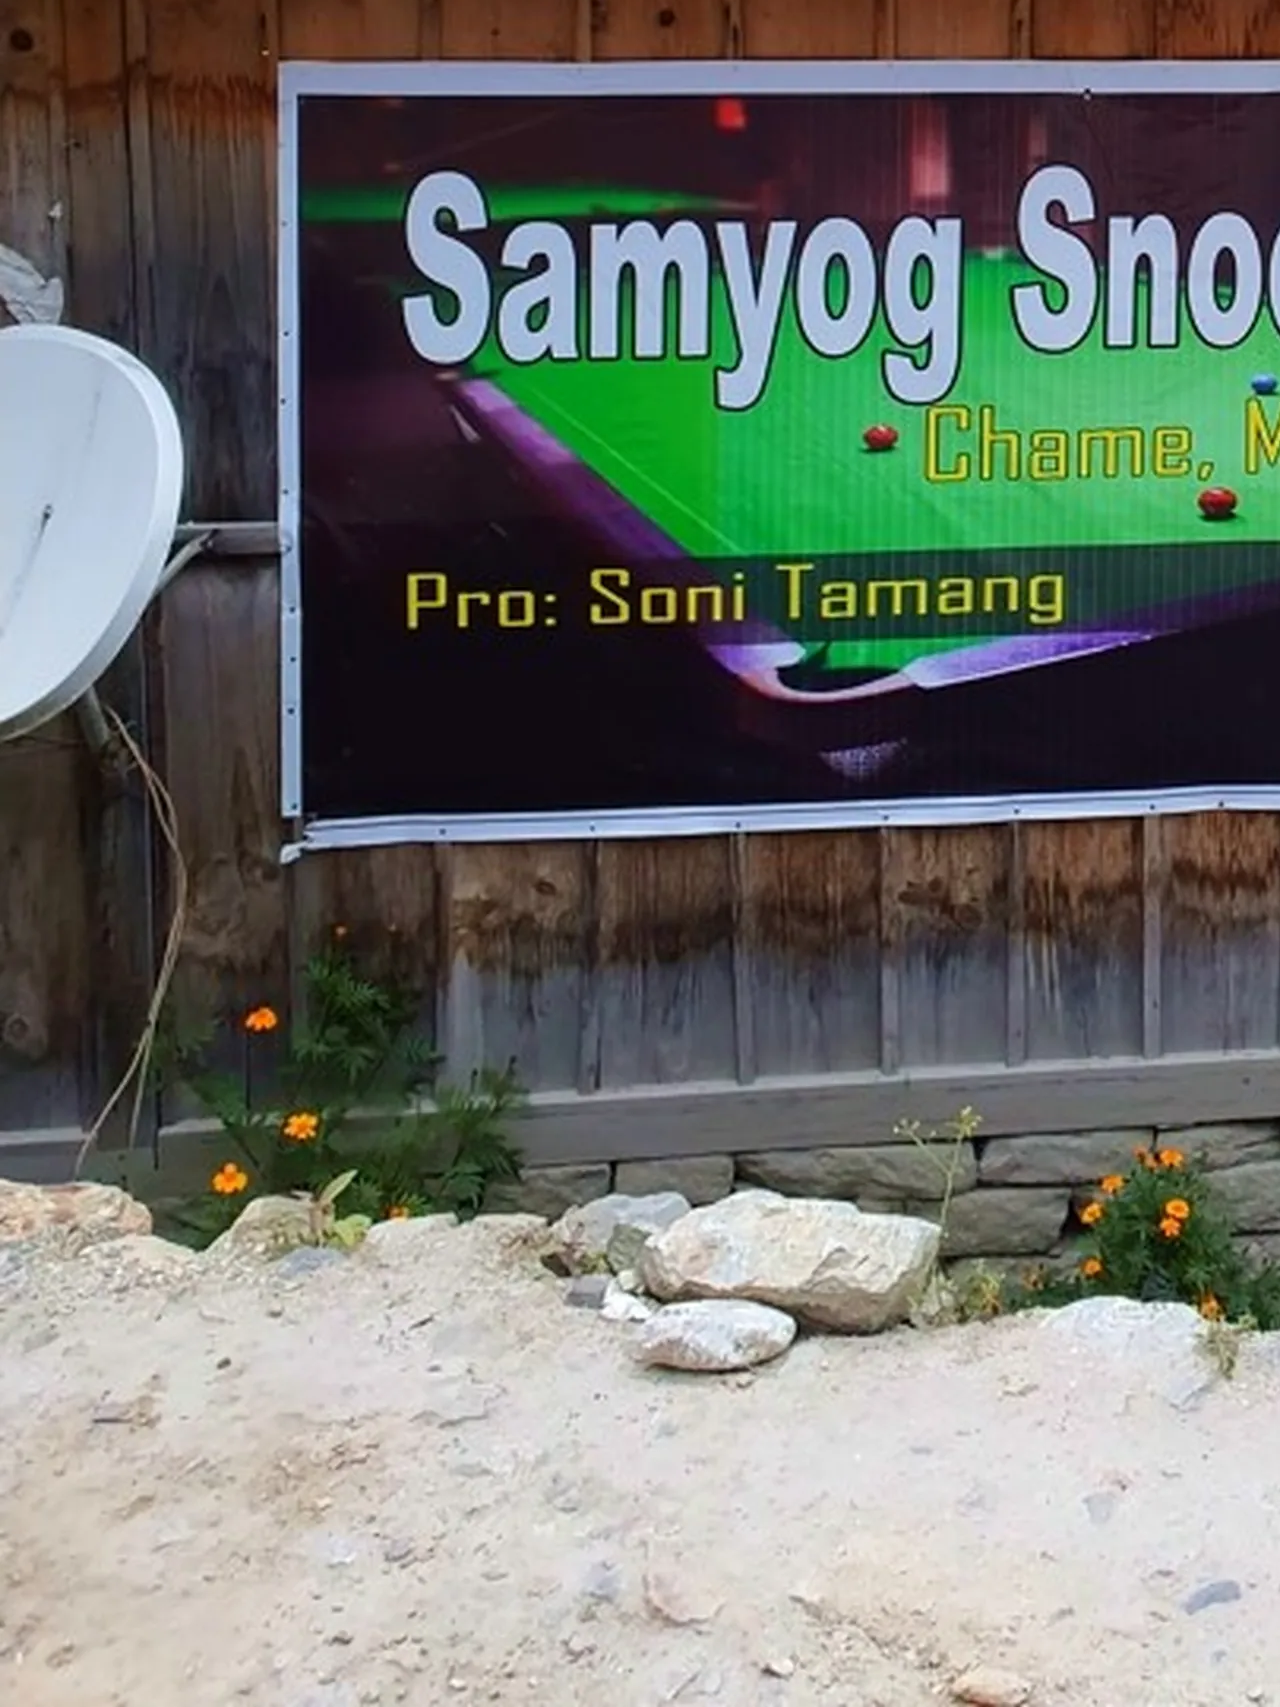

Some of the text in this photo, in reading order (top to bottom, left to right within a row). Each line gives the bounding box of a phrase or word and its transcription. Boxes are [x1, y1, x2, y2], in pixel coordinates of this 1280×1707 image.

[402, 170, 964, 411] Samyog
[923, 404, 1214, 483] Chame,
[406, 563, 1066, 629] Pro: Soni Tamang
